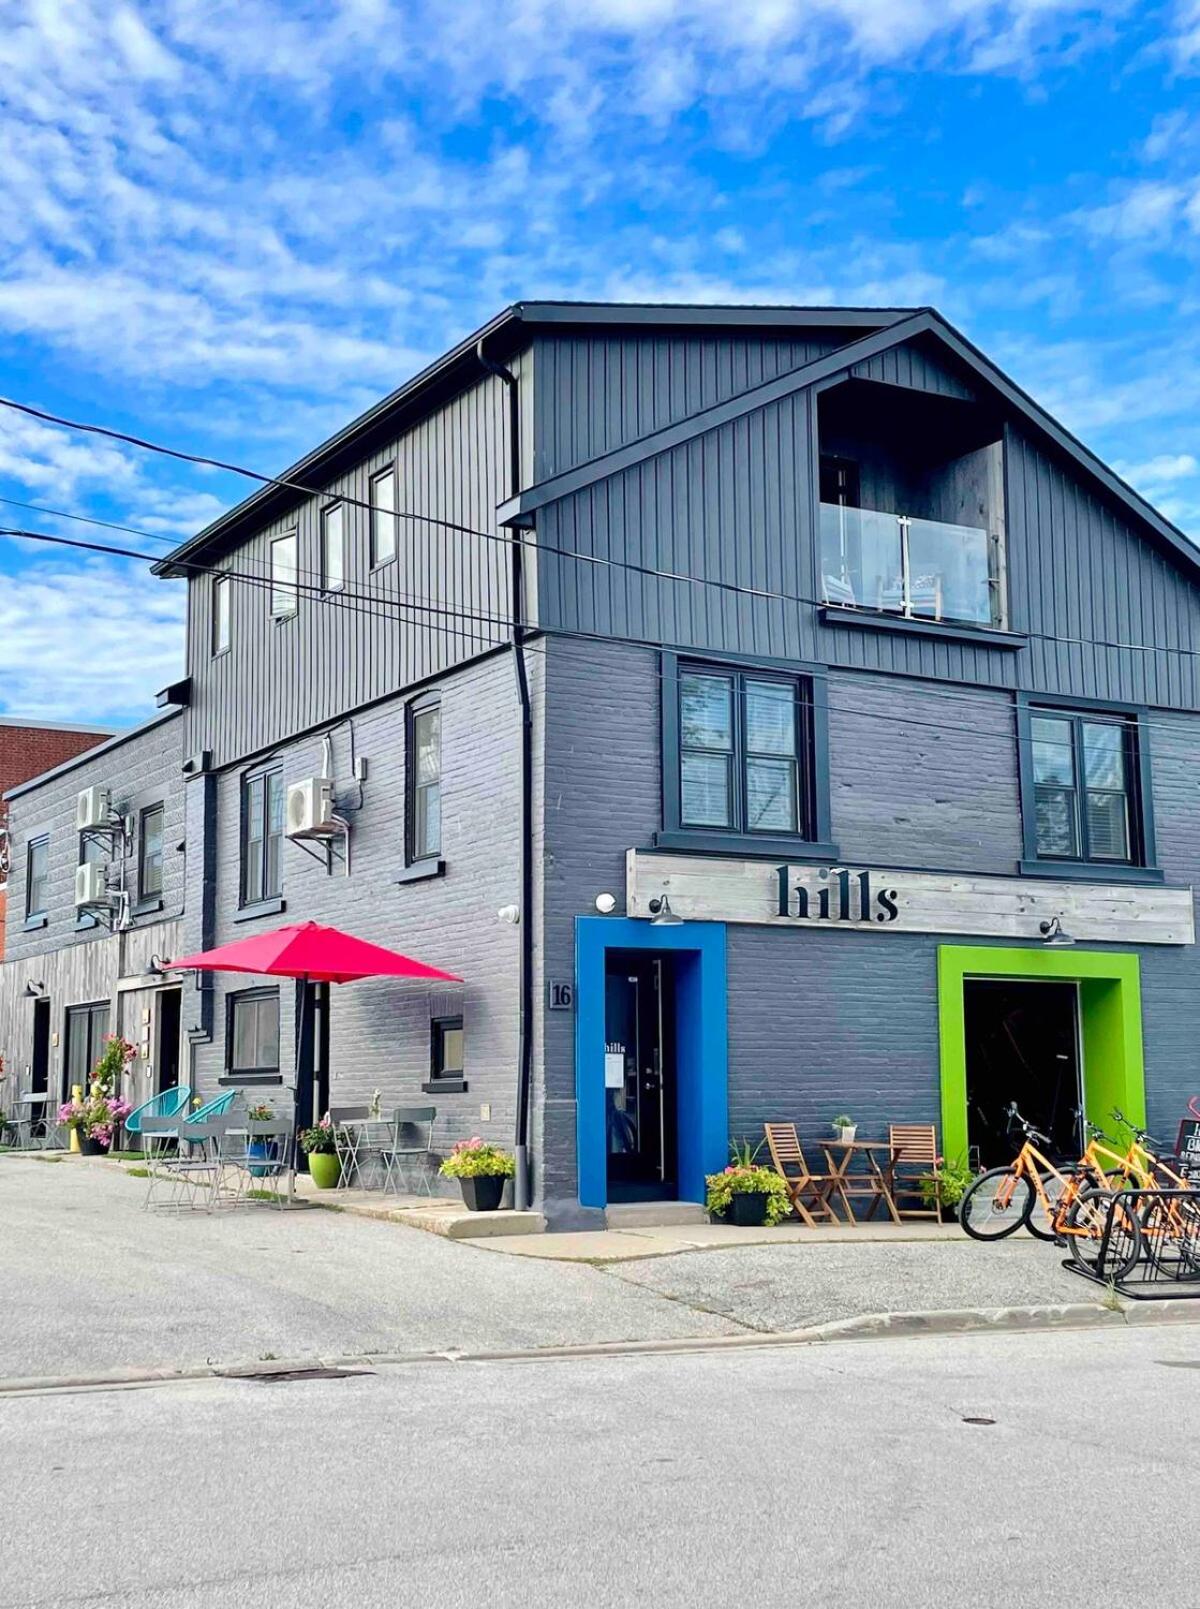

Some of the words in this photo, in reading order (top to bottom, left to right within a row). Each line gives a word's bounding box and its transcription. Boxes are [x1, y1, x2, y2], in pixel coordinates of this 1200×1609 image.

[776, 865, 898, 921] hills
[552, 985, 571, 1006] 16
[604, 1043, 626, 1053] hills
